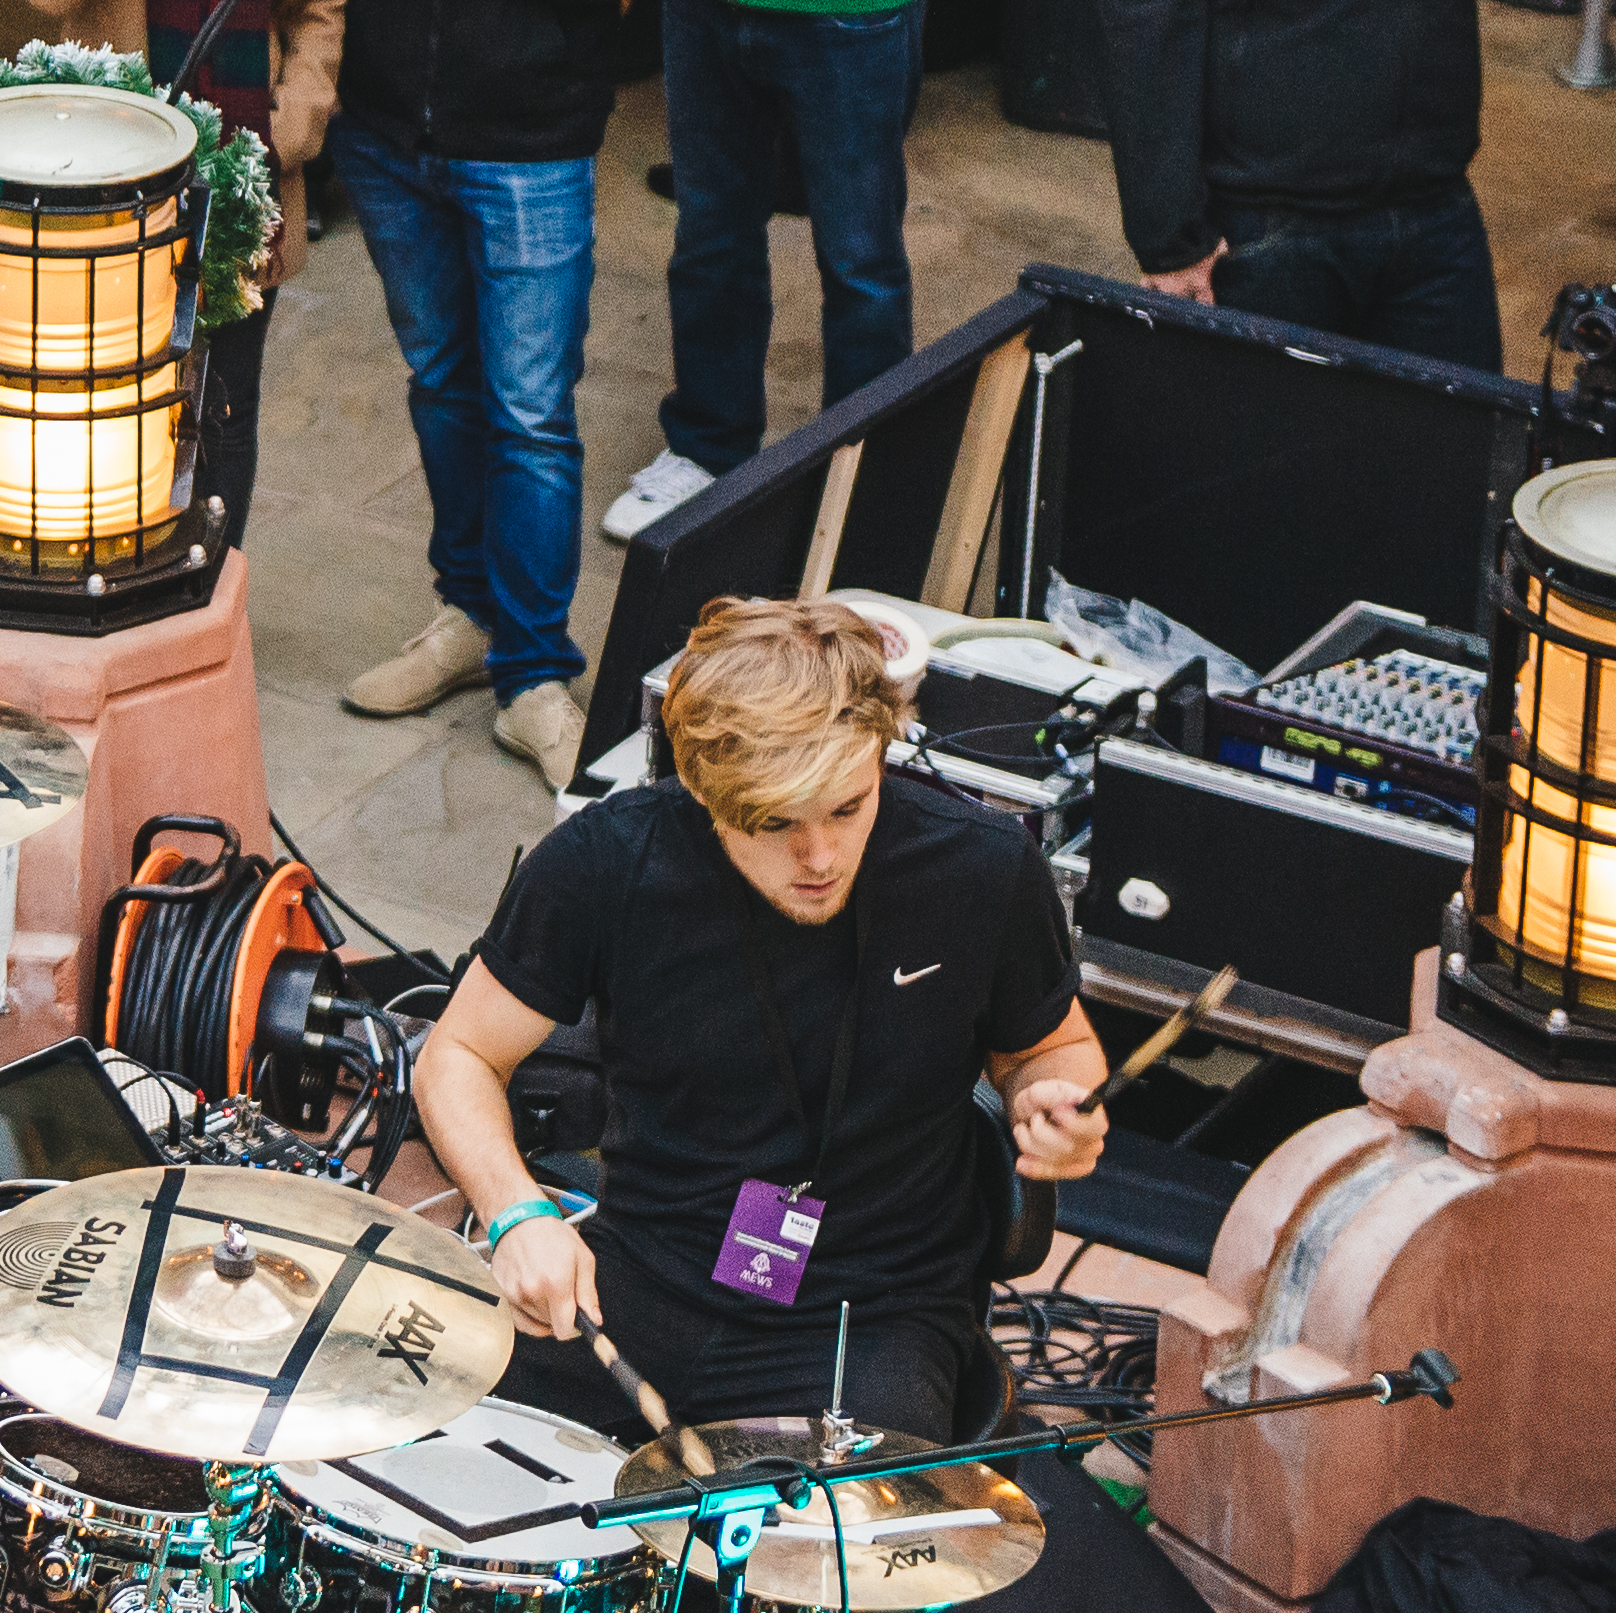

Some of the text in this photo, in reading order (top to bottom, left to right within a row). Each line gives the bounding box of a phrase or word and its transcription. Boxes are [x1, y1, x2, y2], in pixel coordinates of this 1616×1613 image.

[36, 1215, 127, 1309] SABIAN
[739, 1268, 774, 1289] MEWS
[376, 1299, 446, 1387] AAX
[876, 1544, 936, 1578] AAX
